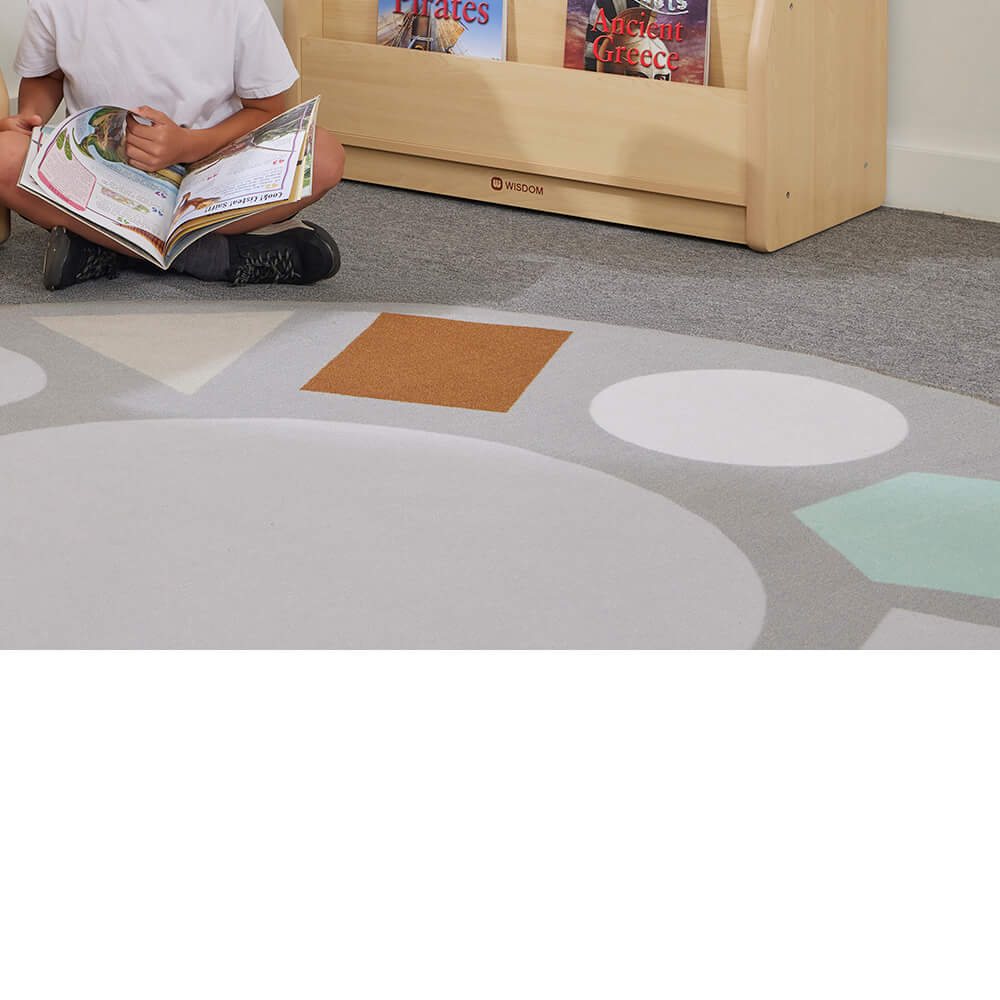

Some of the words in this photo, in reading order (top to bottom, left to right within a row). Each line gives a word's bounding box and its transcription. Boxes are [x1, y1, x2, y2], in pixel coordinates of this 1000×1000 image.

[591, 8, 684, 42] Ancient
[593, 35, 680, 71] Greece
[505, 181, 544, 196] WISDOM
